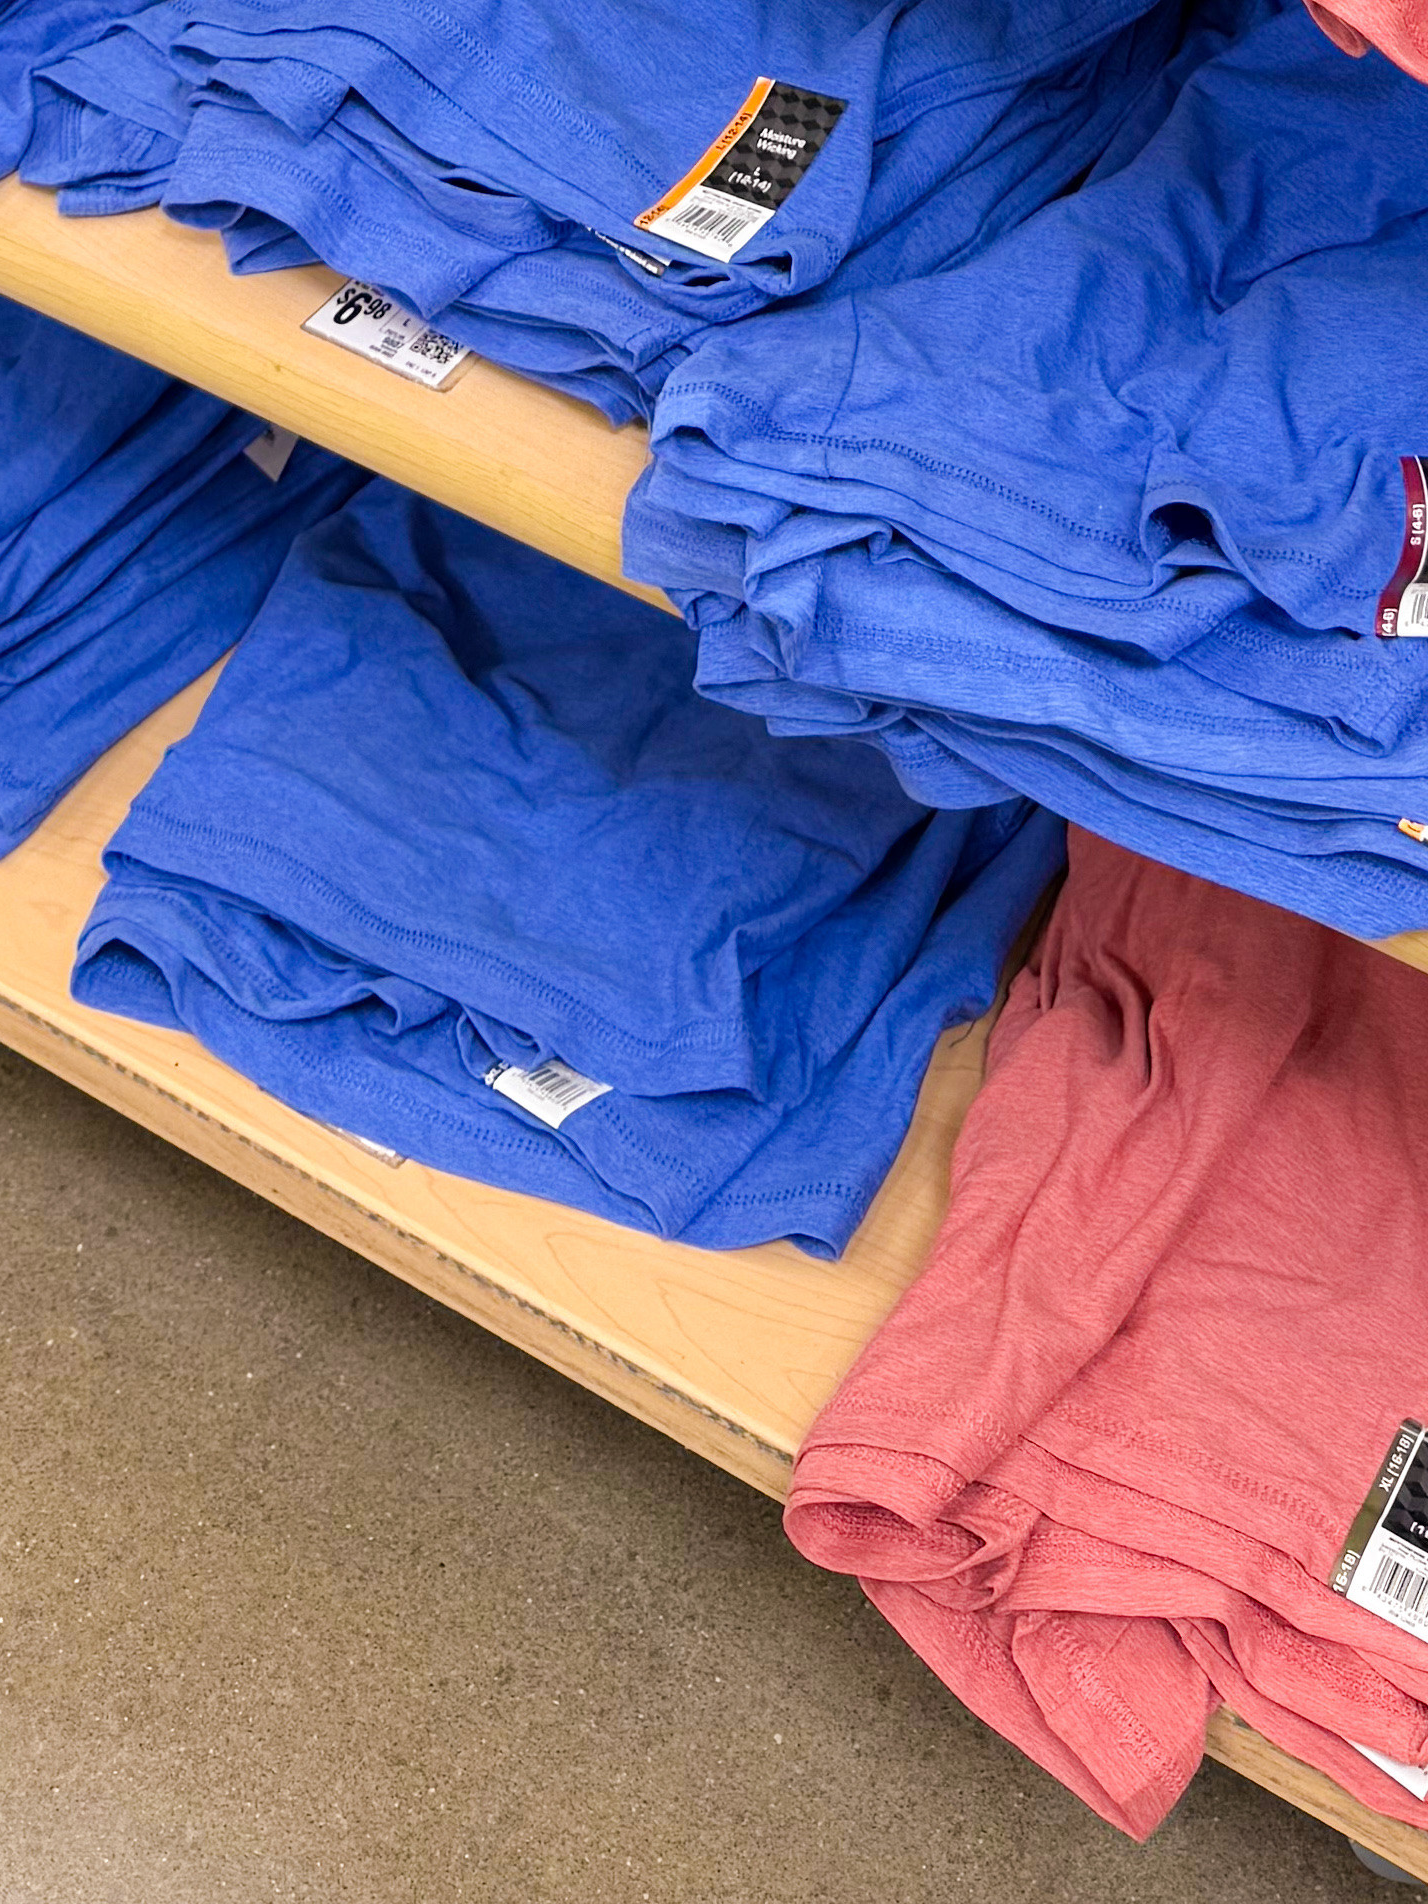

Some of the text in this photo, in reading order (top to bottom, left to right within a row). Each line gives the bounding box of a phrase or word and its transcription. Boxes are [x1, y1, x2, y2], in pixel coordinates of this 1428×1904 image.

[759, 128, 806, 149] Moisture
[1410, 536, 1421, 546] S
[1378, 1434, 1415, 1492] XL (16-18)
